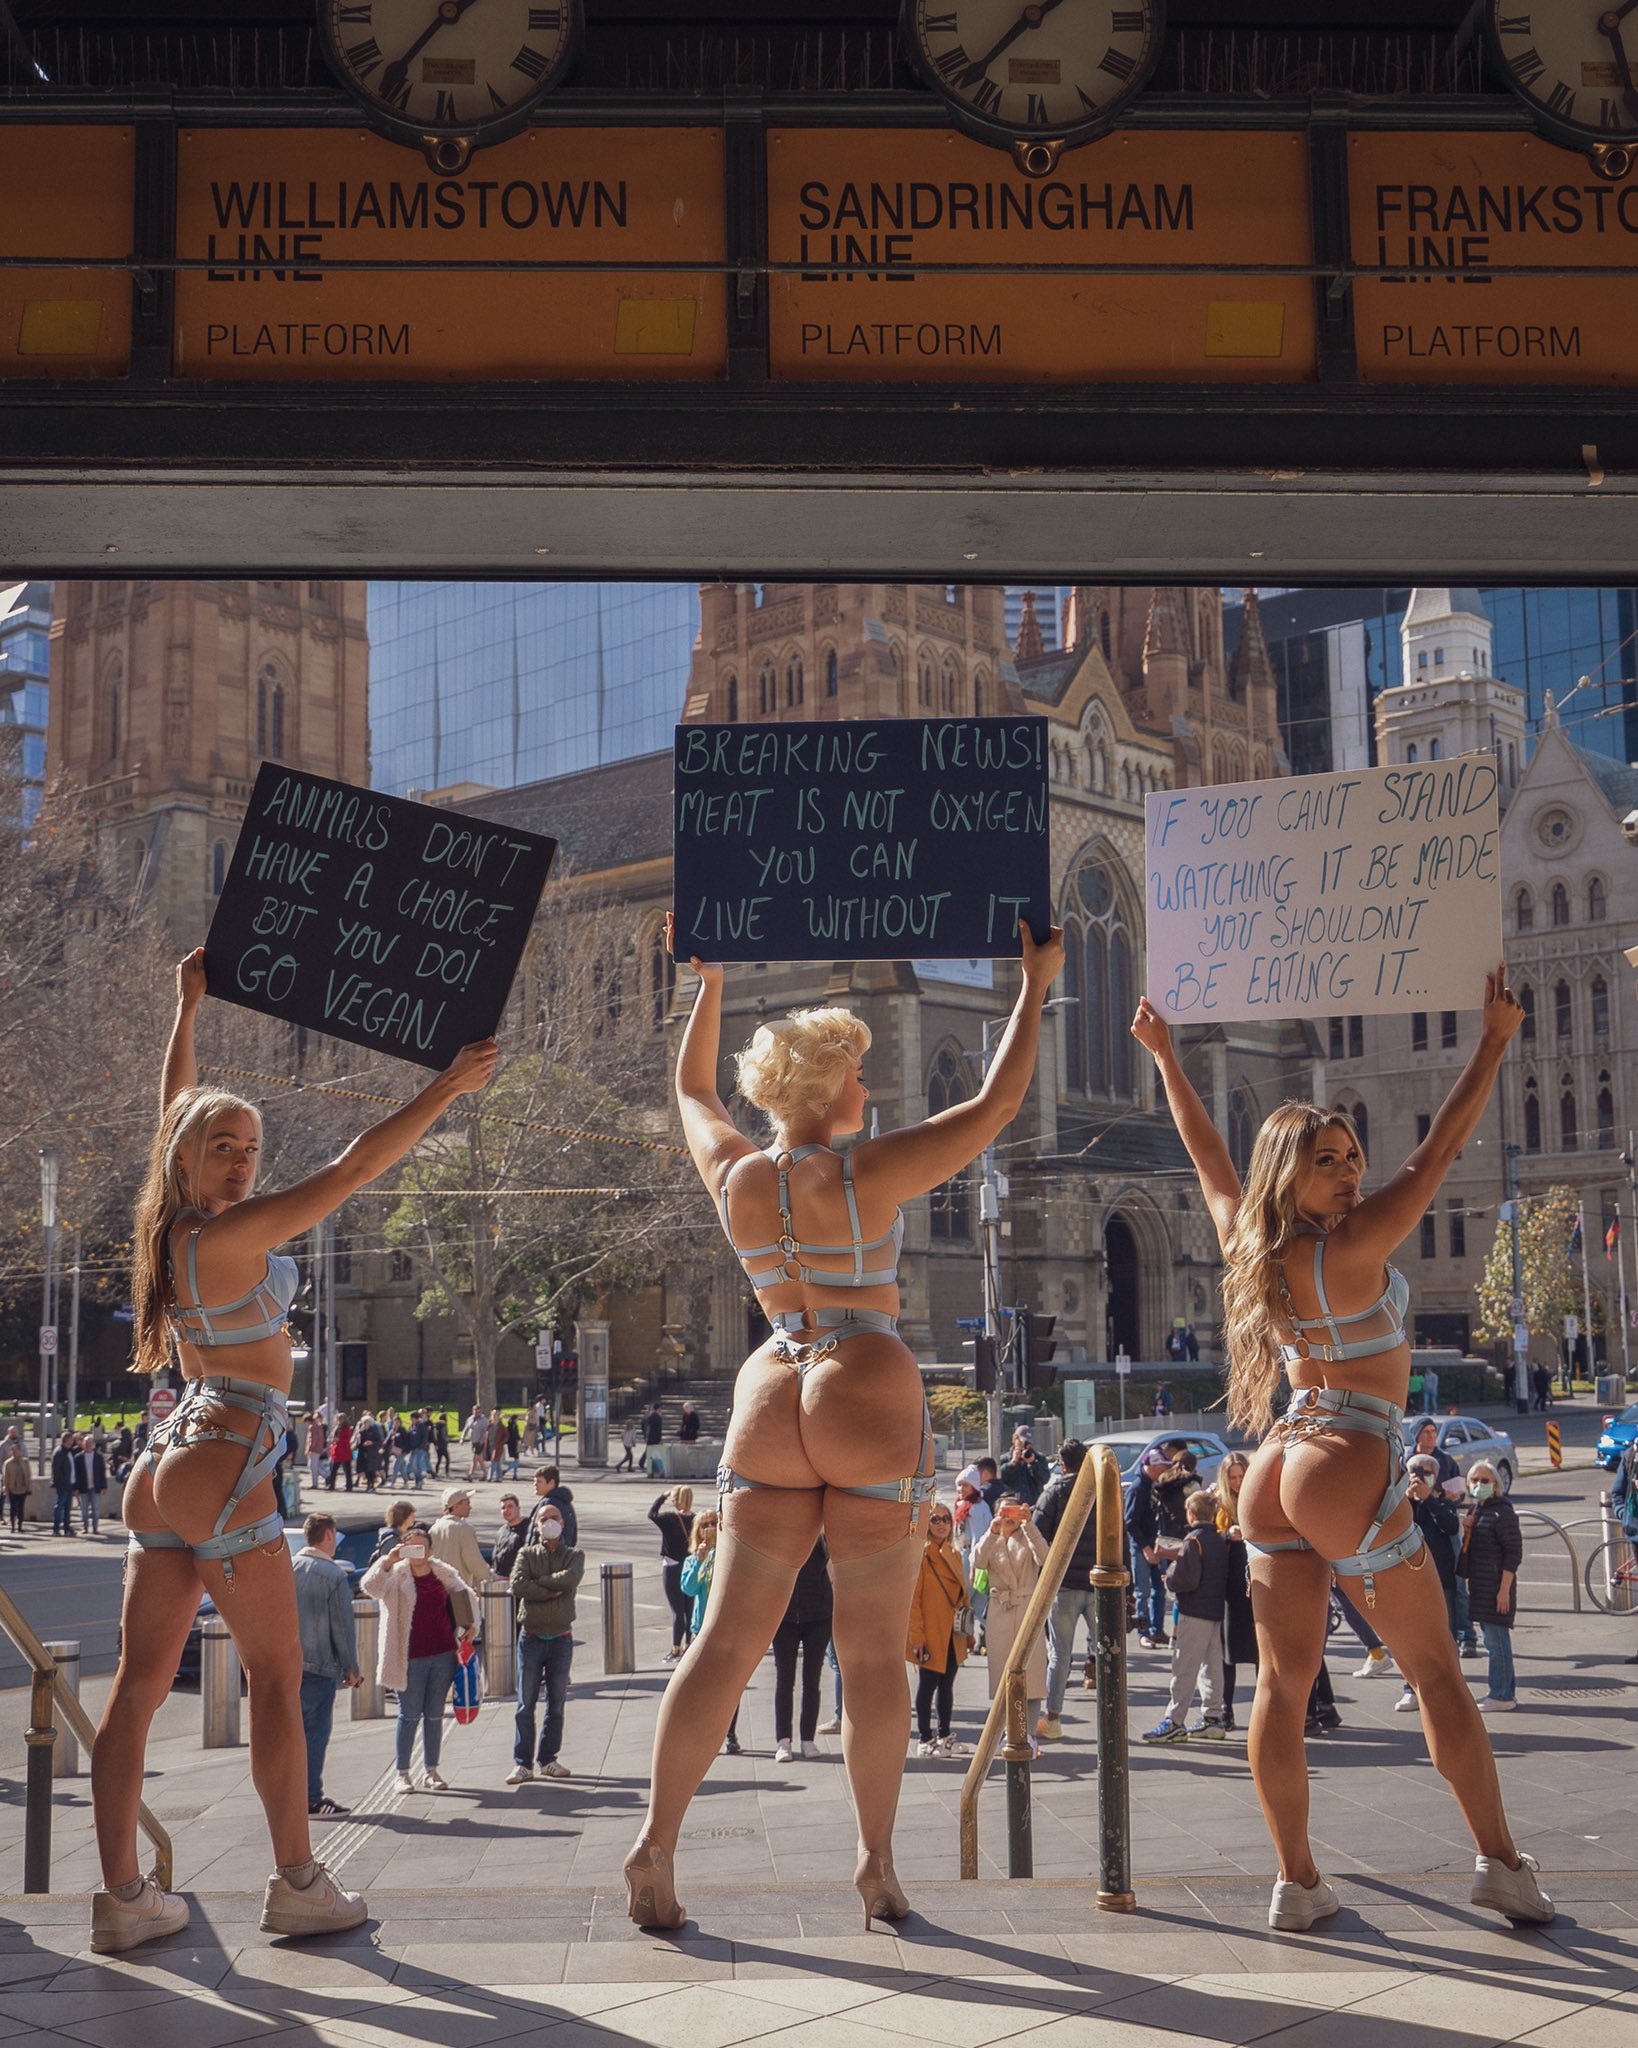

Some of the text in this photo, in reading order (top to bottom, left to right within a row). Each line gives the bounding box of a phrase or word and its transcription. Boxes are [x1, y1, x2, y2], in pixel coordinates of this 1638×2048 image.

[211, 181, 628, 229] WILLIAMSTOWN
[800, 181, 1194, 230] SANDRINGHAM
[206, 234, 322, 282] LINE
[800, 235, 914, 282] LINE
[1378, 237, 1492, 284] LINE
[207, 324, 410, 356] PLATFORM
[801, 323, 1000, 356] PLATFORM
[1383, 325, 1581, 358] PLATFORM
[679, 724, 1042, 776] BREAKING NEWS!
[680, 782, 1047, 837] MEAT IS NOT OXYGEN,
[1152, 763, 1497, 847] IF YOU CAN'T STAND
[263, 777, 532, 887] ANIMALS DON'T
[749, 838, 918, 887] YOU CAN
[1151, 829, 1498, 911] WATCHING IT BE MADE,
[245, 835, 514, 946] HAVE A CHOICE,
[690, 891, 1030, 943] LIVE WITHOUT IT
[1198, 896, 1430, 957] YOU SHOULDN'T
[252, 896, 481, 992] BUT YOU DO!
[237, 944, 446, 1050] GO VEGAN.
[1165, 948, 1428, 1011] BE EATING IT...
